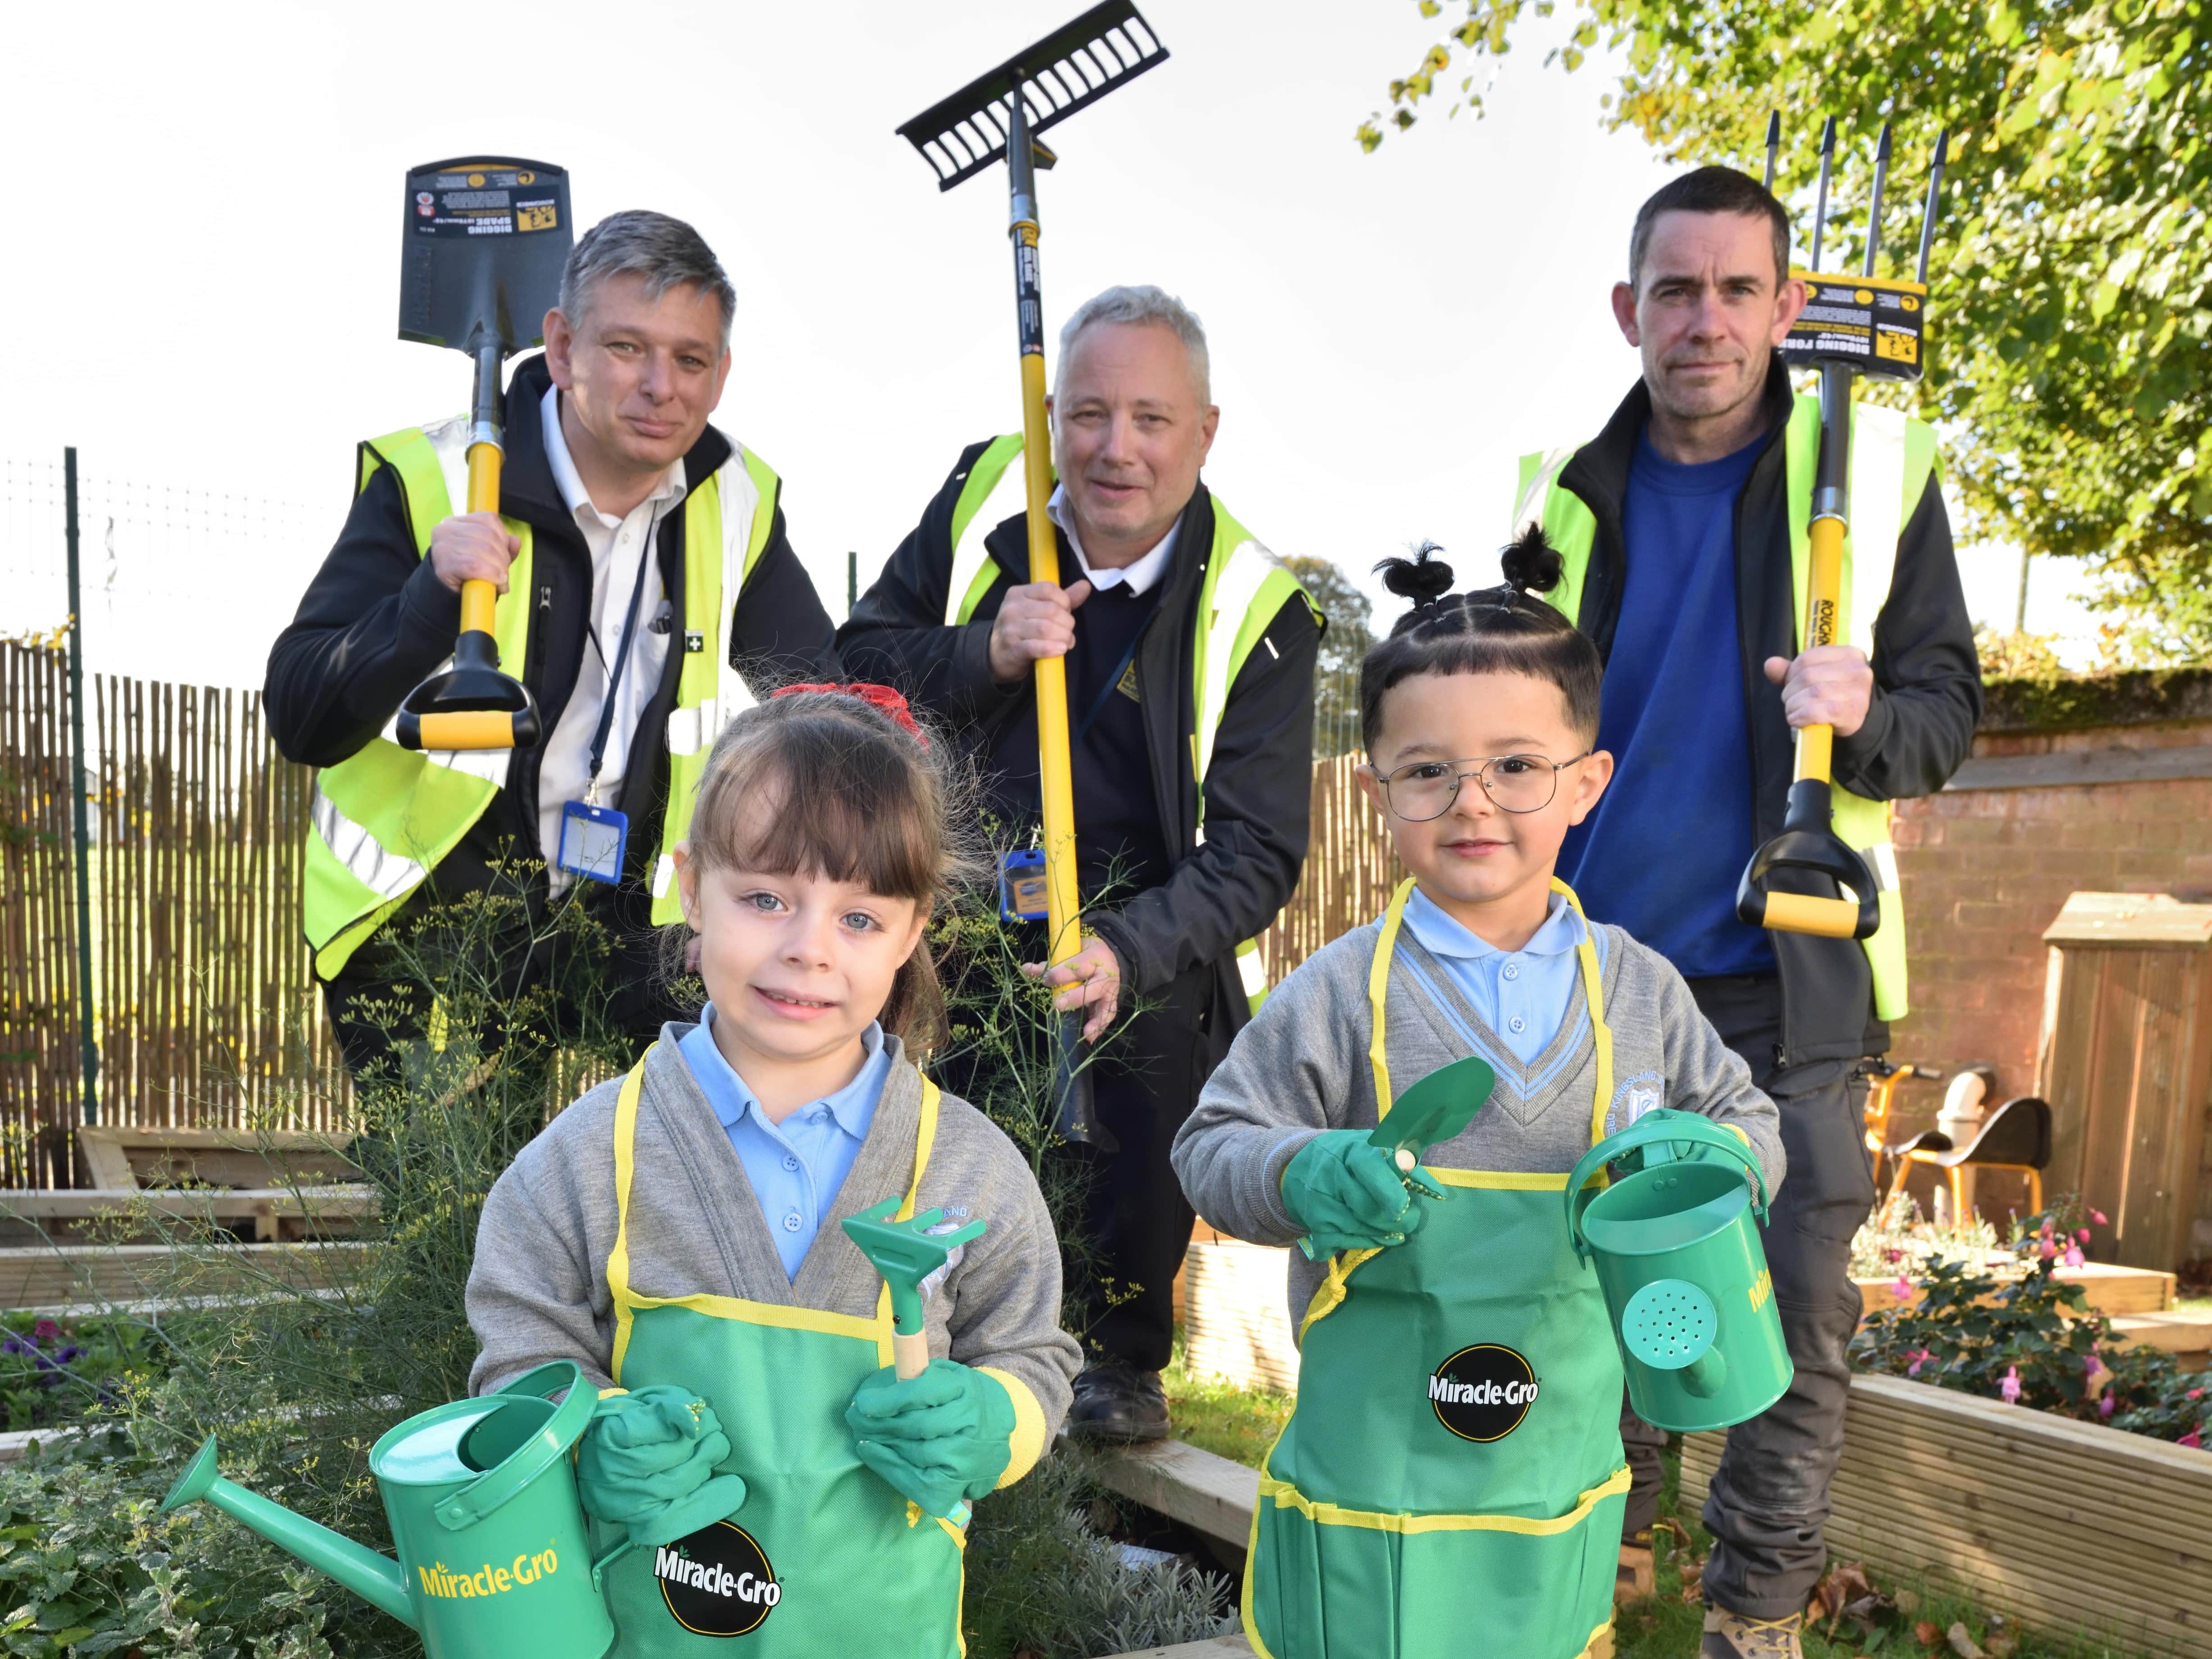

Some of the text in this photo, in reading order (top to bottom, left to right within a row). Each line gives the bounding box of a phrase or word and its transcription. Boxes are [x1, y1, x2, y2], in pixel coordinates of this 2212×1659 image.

[467, 225, 512, 234] DIGGING
[476, 217, 511, 226] SPADE
[1815, 339, 1870, 355] DIGGING
[1818, 599, 1833, 647] ROUGHN
[1611, 1070, 1657, 1109] KINGSLAND
[1606, 1113, 1617, 1135] DRE
[943, 1206, 967, 1217] AND
[1428, 1374, 1538, 1405] Miracle-Gro
[418, 1549, 558, 1598] Miracle-Gro
[654, 1546, 781, 1606] Miracle-Gro
